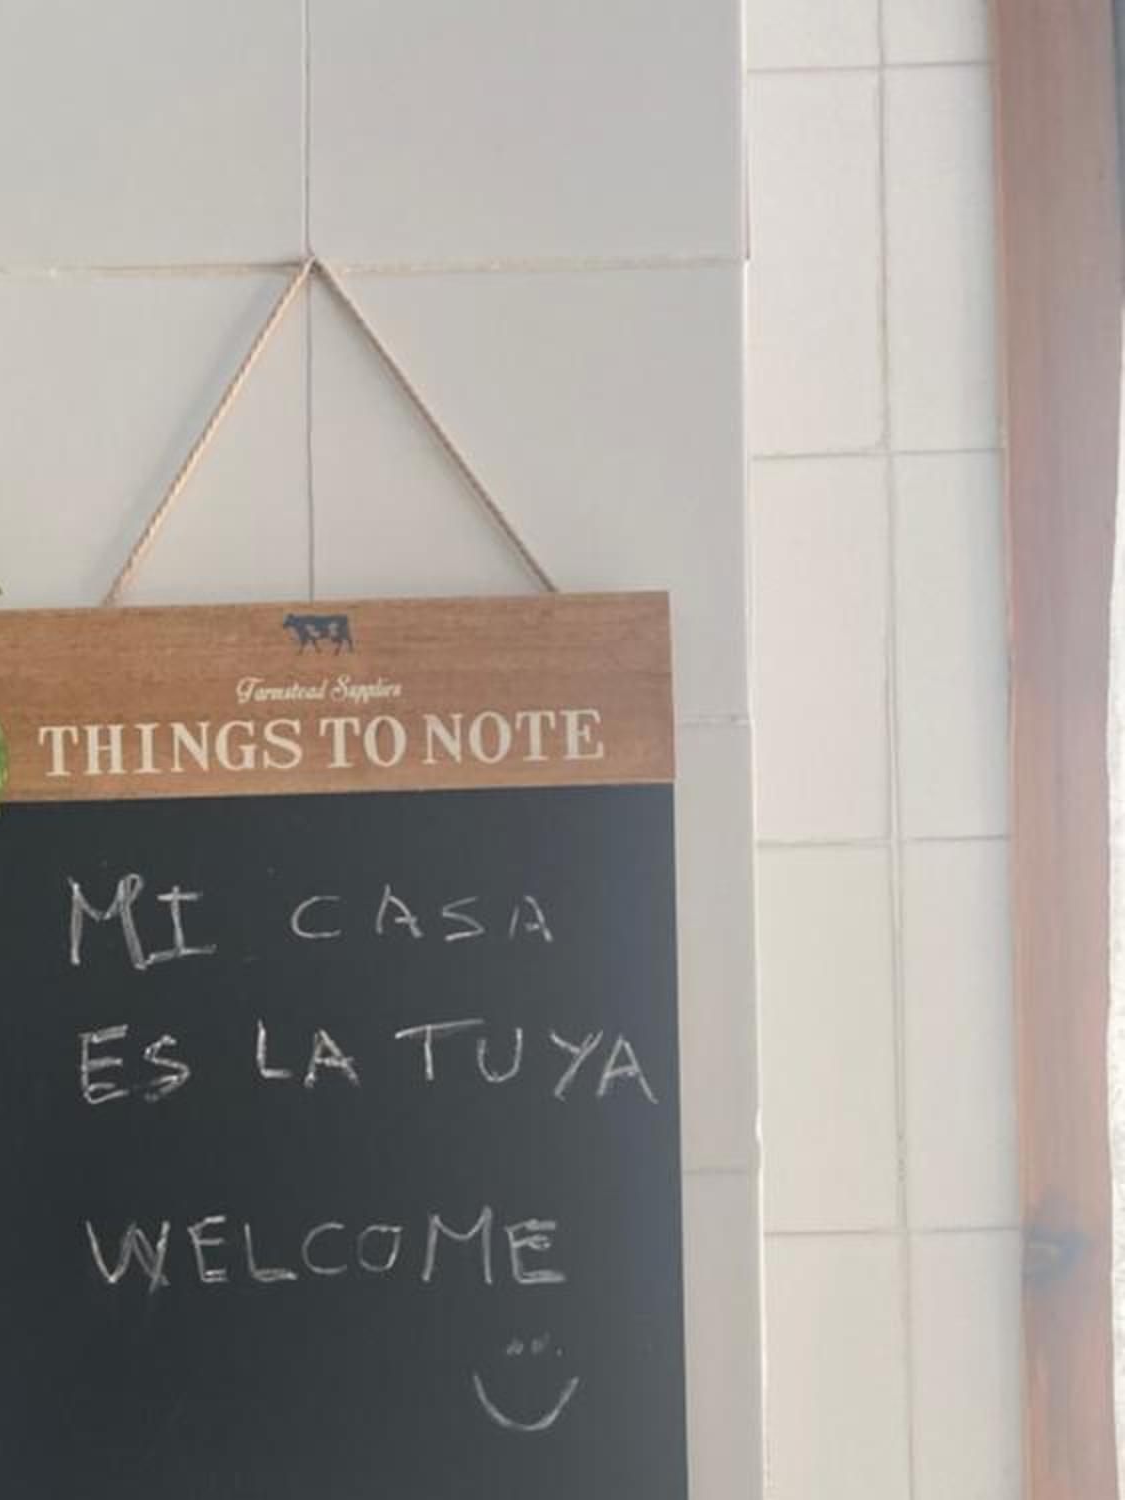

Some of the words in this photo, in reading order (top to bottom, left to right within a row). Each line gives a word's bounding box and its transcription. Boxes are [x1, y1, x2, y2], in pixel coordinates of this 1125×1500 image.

[37, 718, 304, 777] THINGS
[319, 715, 407, 769] TO
[421, 708, 605, 765] NOTE
[67, 873, 217, 970] MI
[291, 884, 553, 942] CASA
[78, 1023, 190, 1104] ES
[256, 1019, 361, 1088] LA
[394, 1018, 658, 1104] TUYA
[85, 1206, 567, 1294] WELCOME
